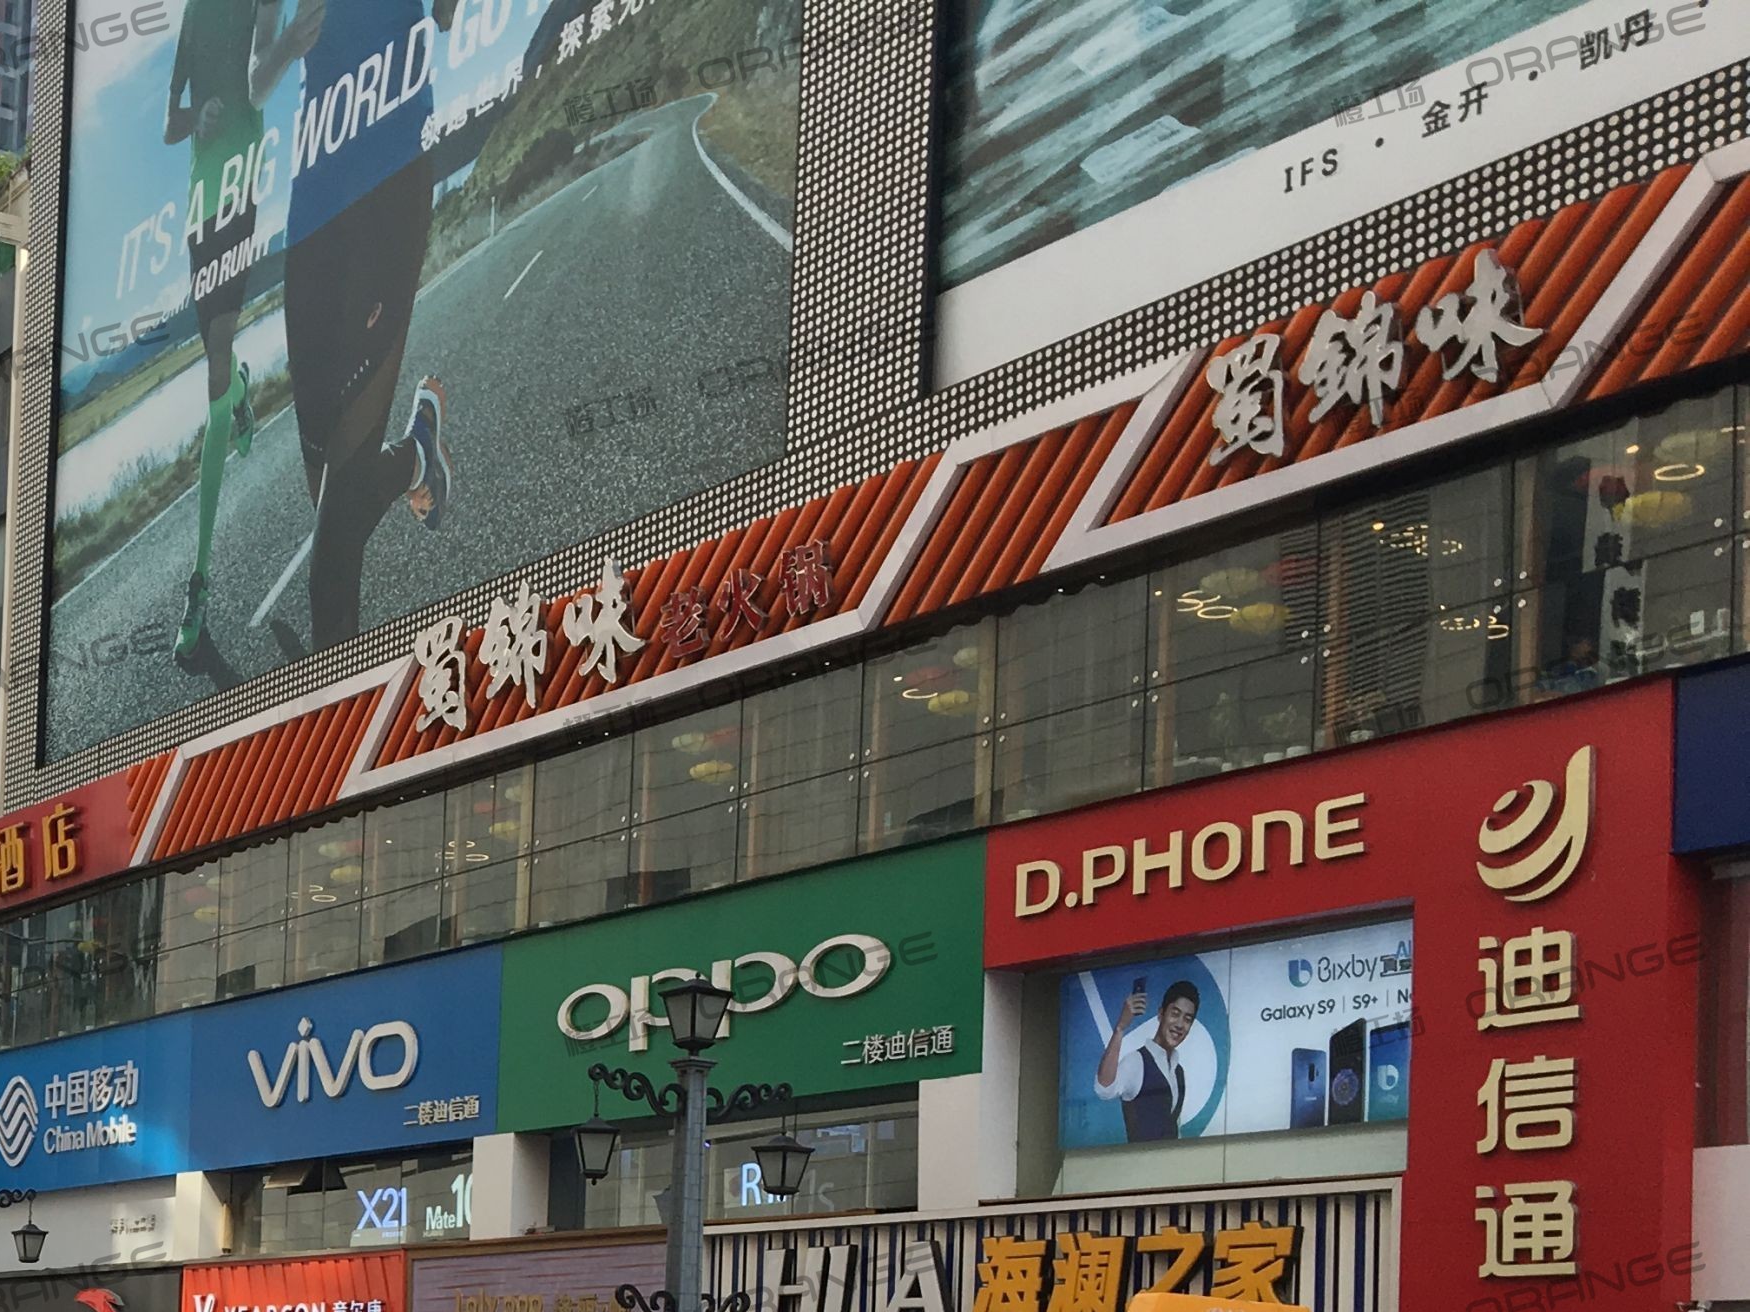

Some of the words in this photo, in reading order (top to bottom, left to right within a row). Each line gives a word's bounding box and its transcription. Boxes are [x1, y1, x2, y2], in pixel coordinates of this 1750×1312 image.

[214, 129, 279, 239] BIG
[1283, 147, 1340, 193] IFS
[1014, 792, 1368, 919] D.PHONE
[1318, 953, 1378, 983] Bixby
[1261, 1002, 1315, 1022] Galaxy
[1317, 999, 1336, 1015] S9
[247, 1016, 420, 1108] vivo
[840, 1025, 955, 1066] 二楼迪信通
[44, 1060, 140, 1121] 中国移动
[1475, 926, 1583, 1279] 迪信通
[85, 1114, 137, 1149] Mobile
[357, 1186, 408, 1230] X21
